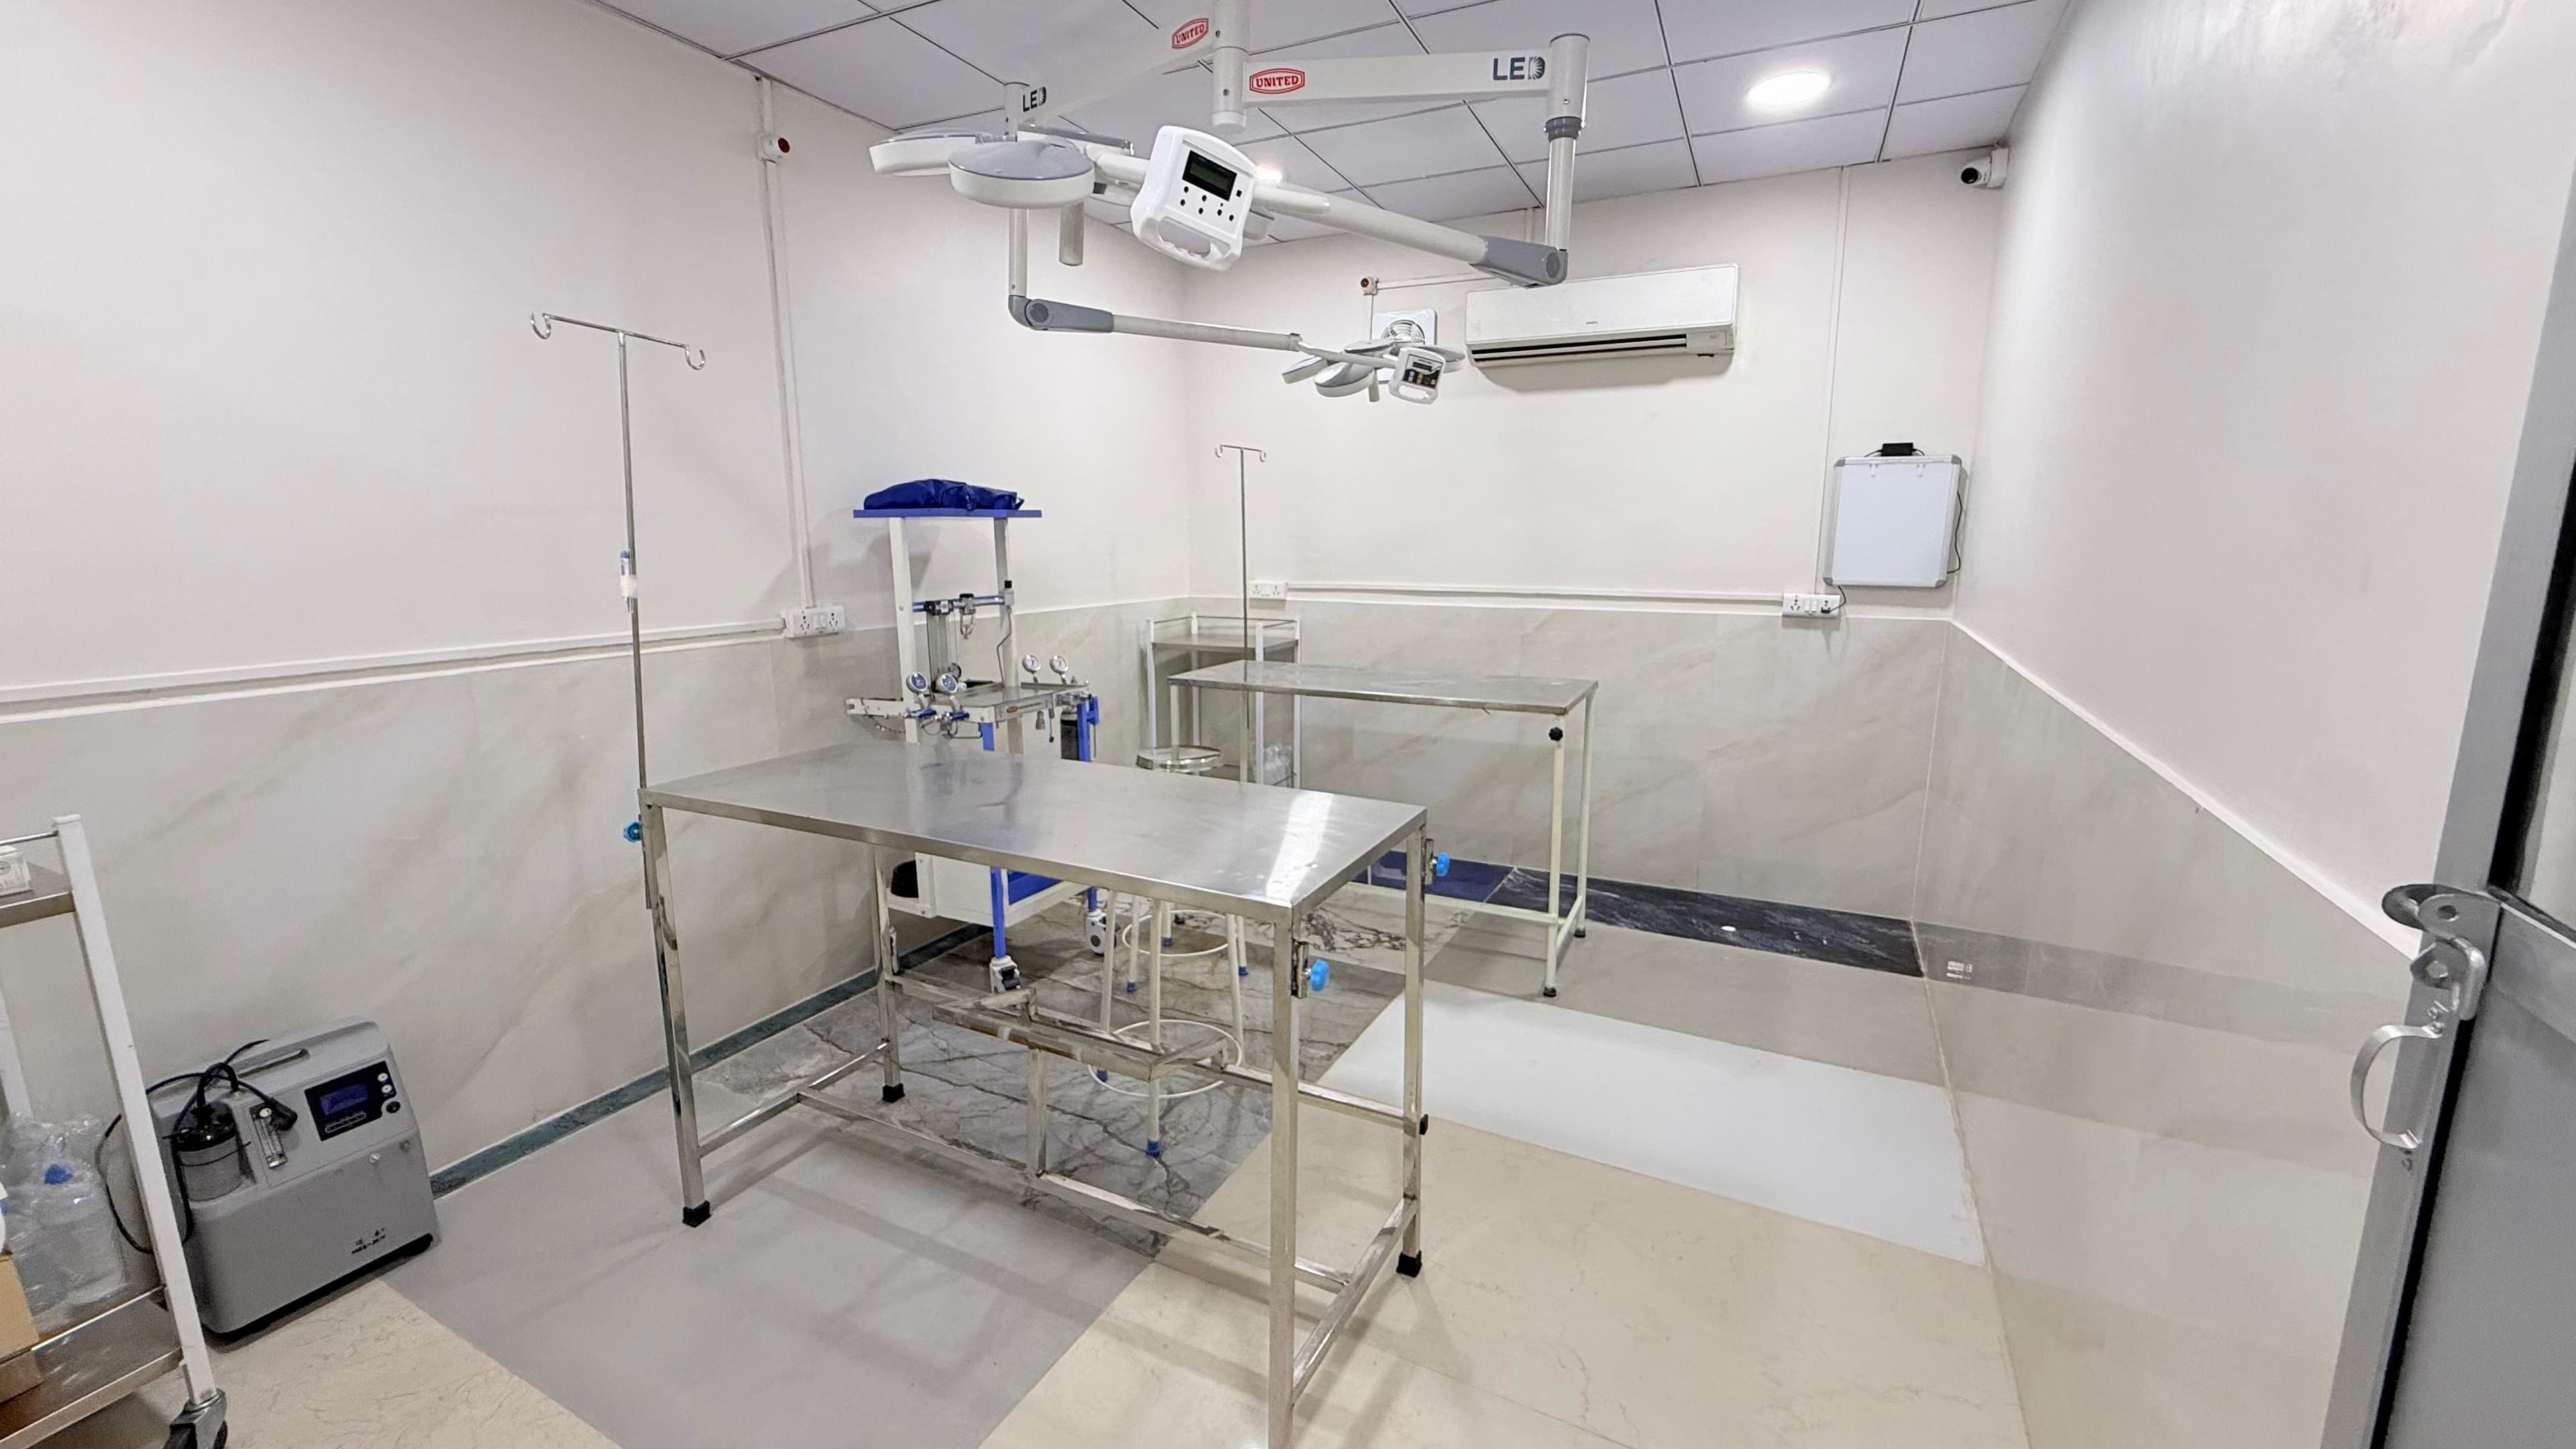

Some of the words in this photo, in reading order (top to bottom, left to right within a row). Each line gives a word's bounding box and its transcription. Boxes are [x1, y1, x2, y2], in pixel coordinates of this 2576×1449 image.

[1175, 23, 1205, 44] UNITED
[1493, 56, 1546, 80] LED
[1256, 76, 1299, 87] UNITED
[1022, 87, 1046, 113] LED
